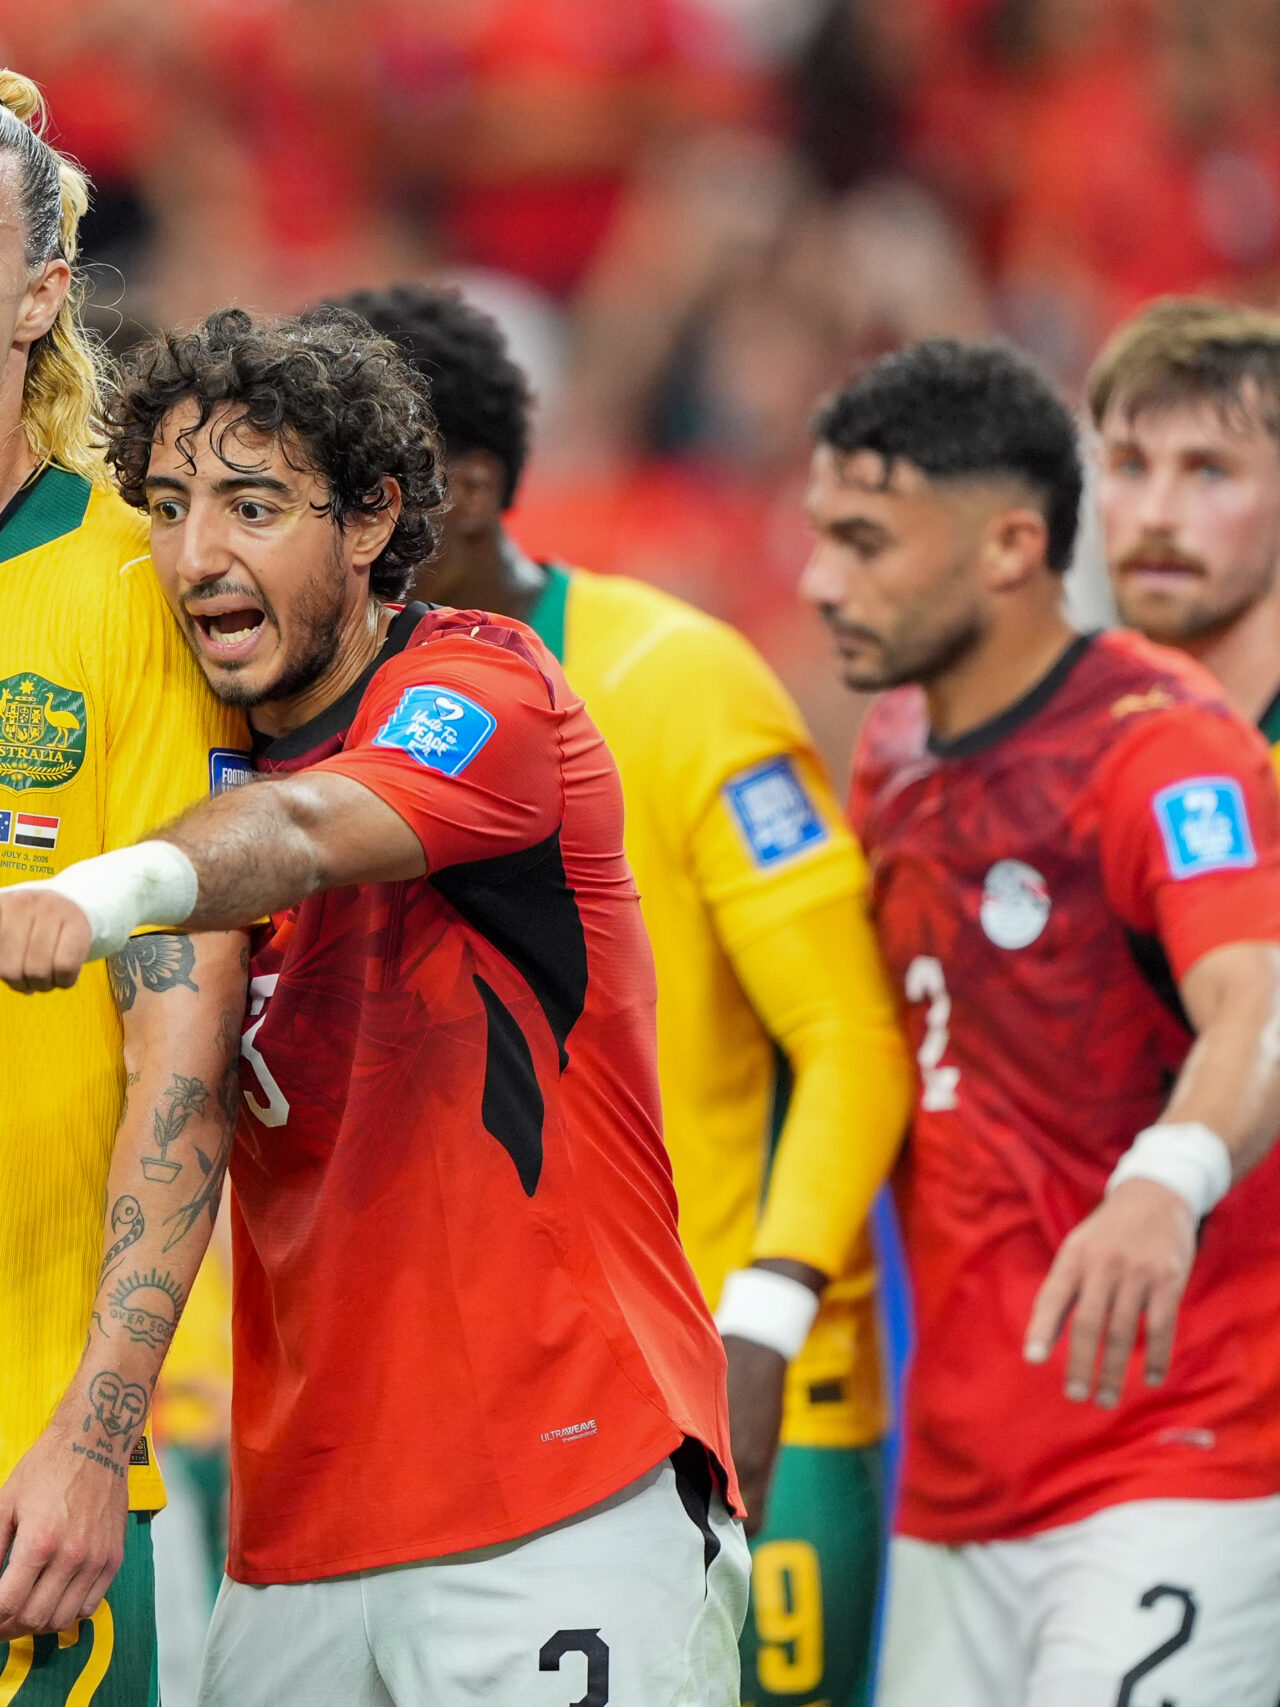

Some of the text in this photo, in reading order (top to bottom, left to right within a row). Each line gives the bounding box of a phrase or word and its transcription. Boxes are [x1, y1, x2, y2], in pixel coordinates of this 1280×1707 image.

[1, 851, 22, 860] JULY
[23, 854, 31, 862] 3,
[33, 855, 49, 863] 2026
[904, 954, 961, 1112] 2
[110, 1309, 145, 1326] OVER
[540, 1419, 597, 1442] ULTRAWEAVE
[96, 1437, 113, 1453] NO
